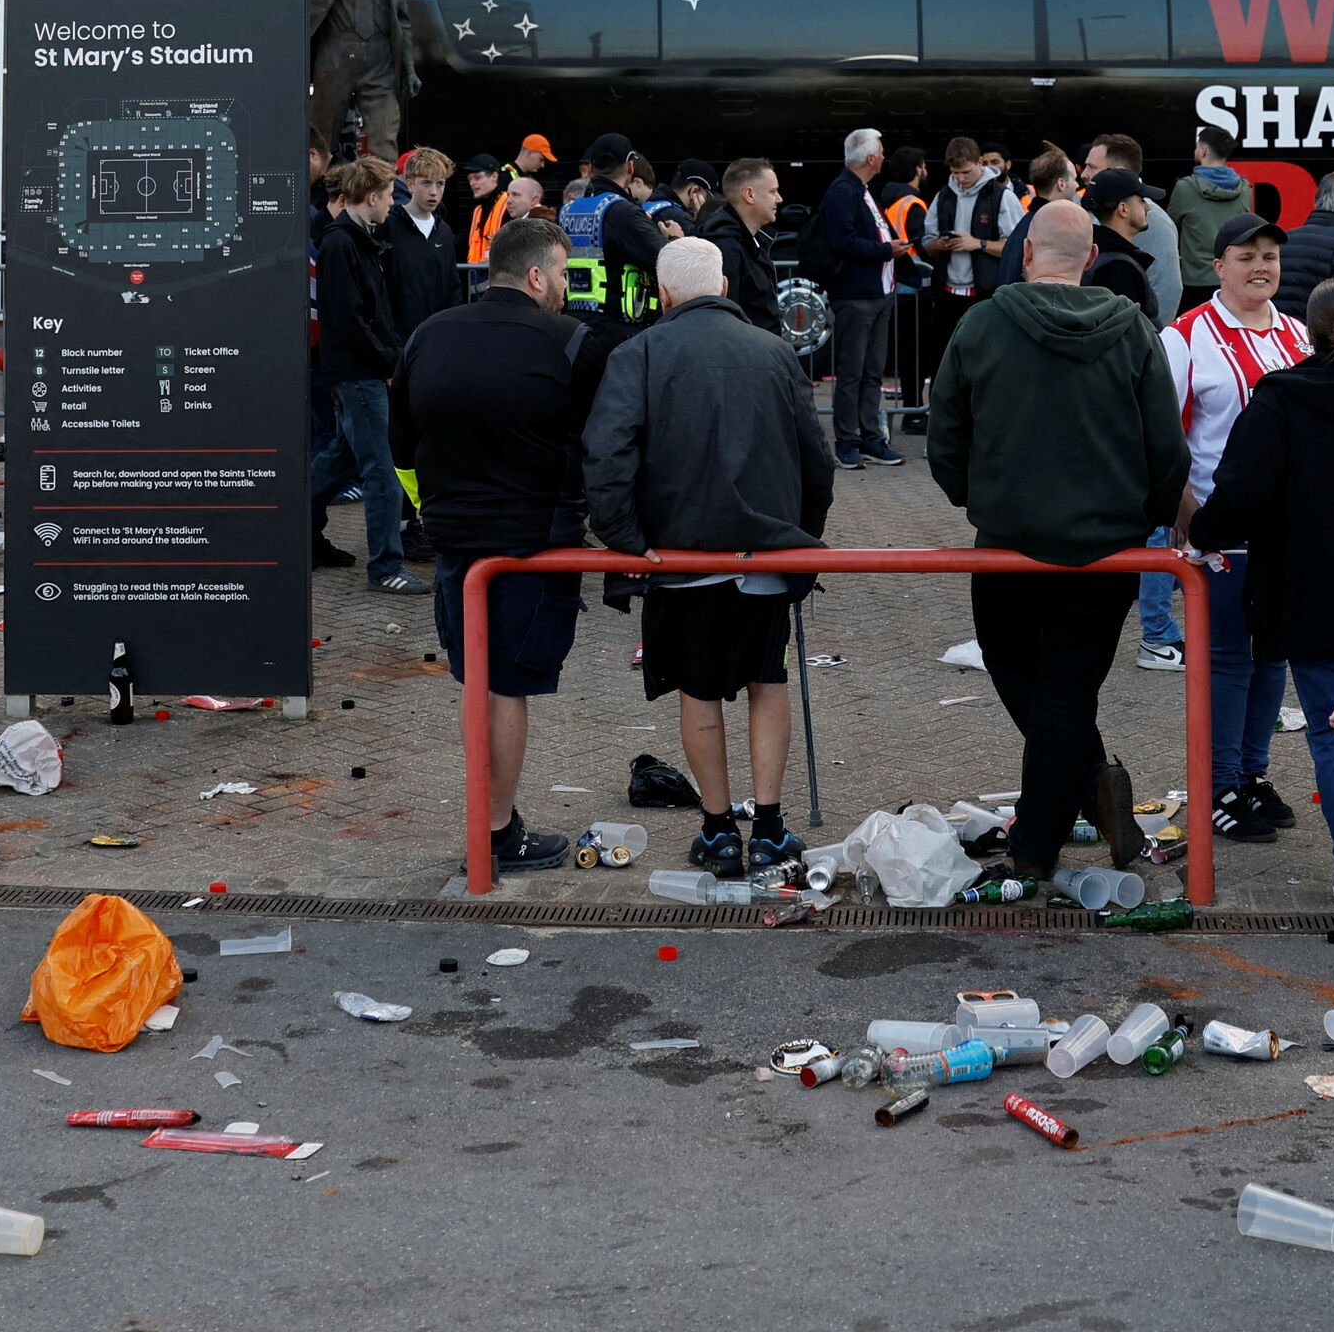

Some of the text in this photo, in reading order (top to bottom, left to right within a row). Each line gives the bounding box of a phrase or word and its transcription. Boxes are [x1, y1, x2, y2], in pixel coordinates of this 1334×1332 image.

[35, 21, 175, 41] Welcome to
[35, 44, 253, 71] St Mary's Stadium
[564, 218, 594, 232] POLICE
[33, 317, 63, 333] Key
[35, 348, 123, 357] 12 Block number
[159, 347, 239, 356] TO Ticket Office
[62, 366, 99, 375] Turnstile
[101, 366, 125, 374] letter
[184, 365, 215, 374] Screen
[62, 384, 102, 392] Activities
[184, 384, 206, 392] Food
[62, 402, 87, 410] Retail
[184, 401, 212, 410] Drinks
[62, 420, 140, 428] Accessible Toilets
[73, 469, 276, 479] Search for, download and open the Saints Tickets
[73, 480, 90, 489] App
[92, 480, 119, 488] before
[121, 479, 152, 489] making
[154, 481, 173, 489] your
[175, 481, 192, 489] way
[204, 479, 218, 487] the
[220, 479, 255, 487] turnstile.
[73, 527, 110, 535] Connect
[112, 527, 120, 535] to
[73, 536, 209, 545] WiFi in and around the stadium.
[73, 582, 244, 594] Struggling to read this map? Accessible
[73, 593, 109, 601] versions
[128, 592, 168, 601] available
[170, 593, 179, 601] at
[181, 593, 202, 601] Main
[204, 592, 250, 602] Reception.
